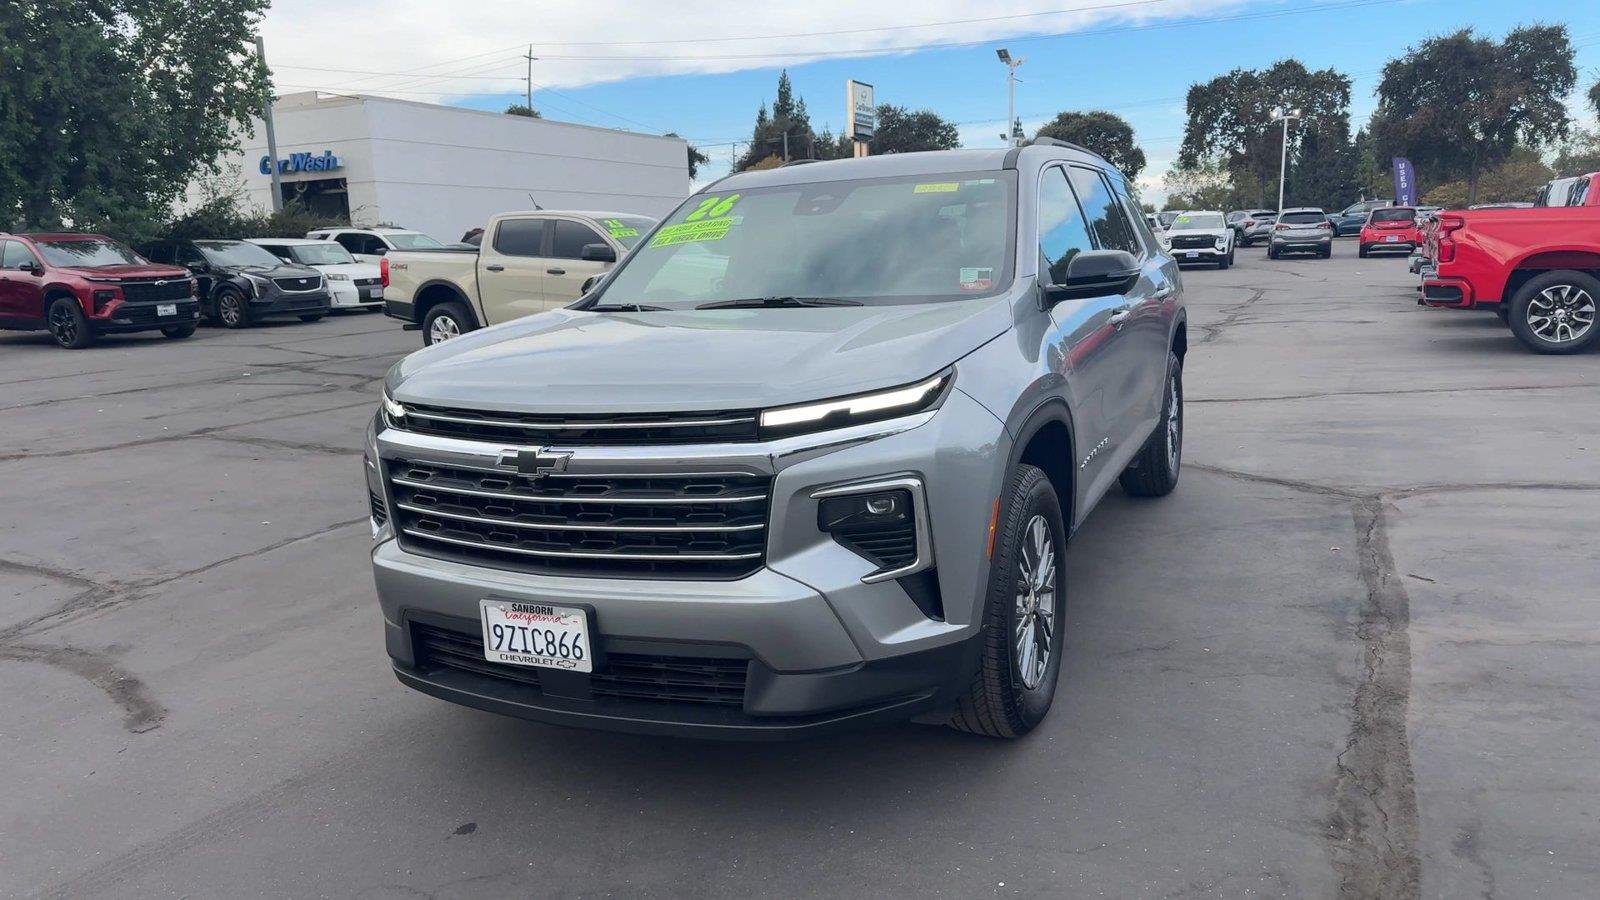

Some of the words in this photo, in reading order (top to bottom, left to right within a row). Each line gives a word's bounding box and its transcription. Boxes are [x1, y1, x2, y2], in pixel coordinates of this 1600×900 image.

[259, 155, 289, 174] Cr
[289, 150, 338, 171] Wash
[1399, 162, 1407, 189] USED
[685, 194, 740, 221] 26
[511, 603, 554, 616] SANBORN
[492, 623, 584, 660] 9ZIC866
[499, 653, 555, 666] CHEVROLET
